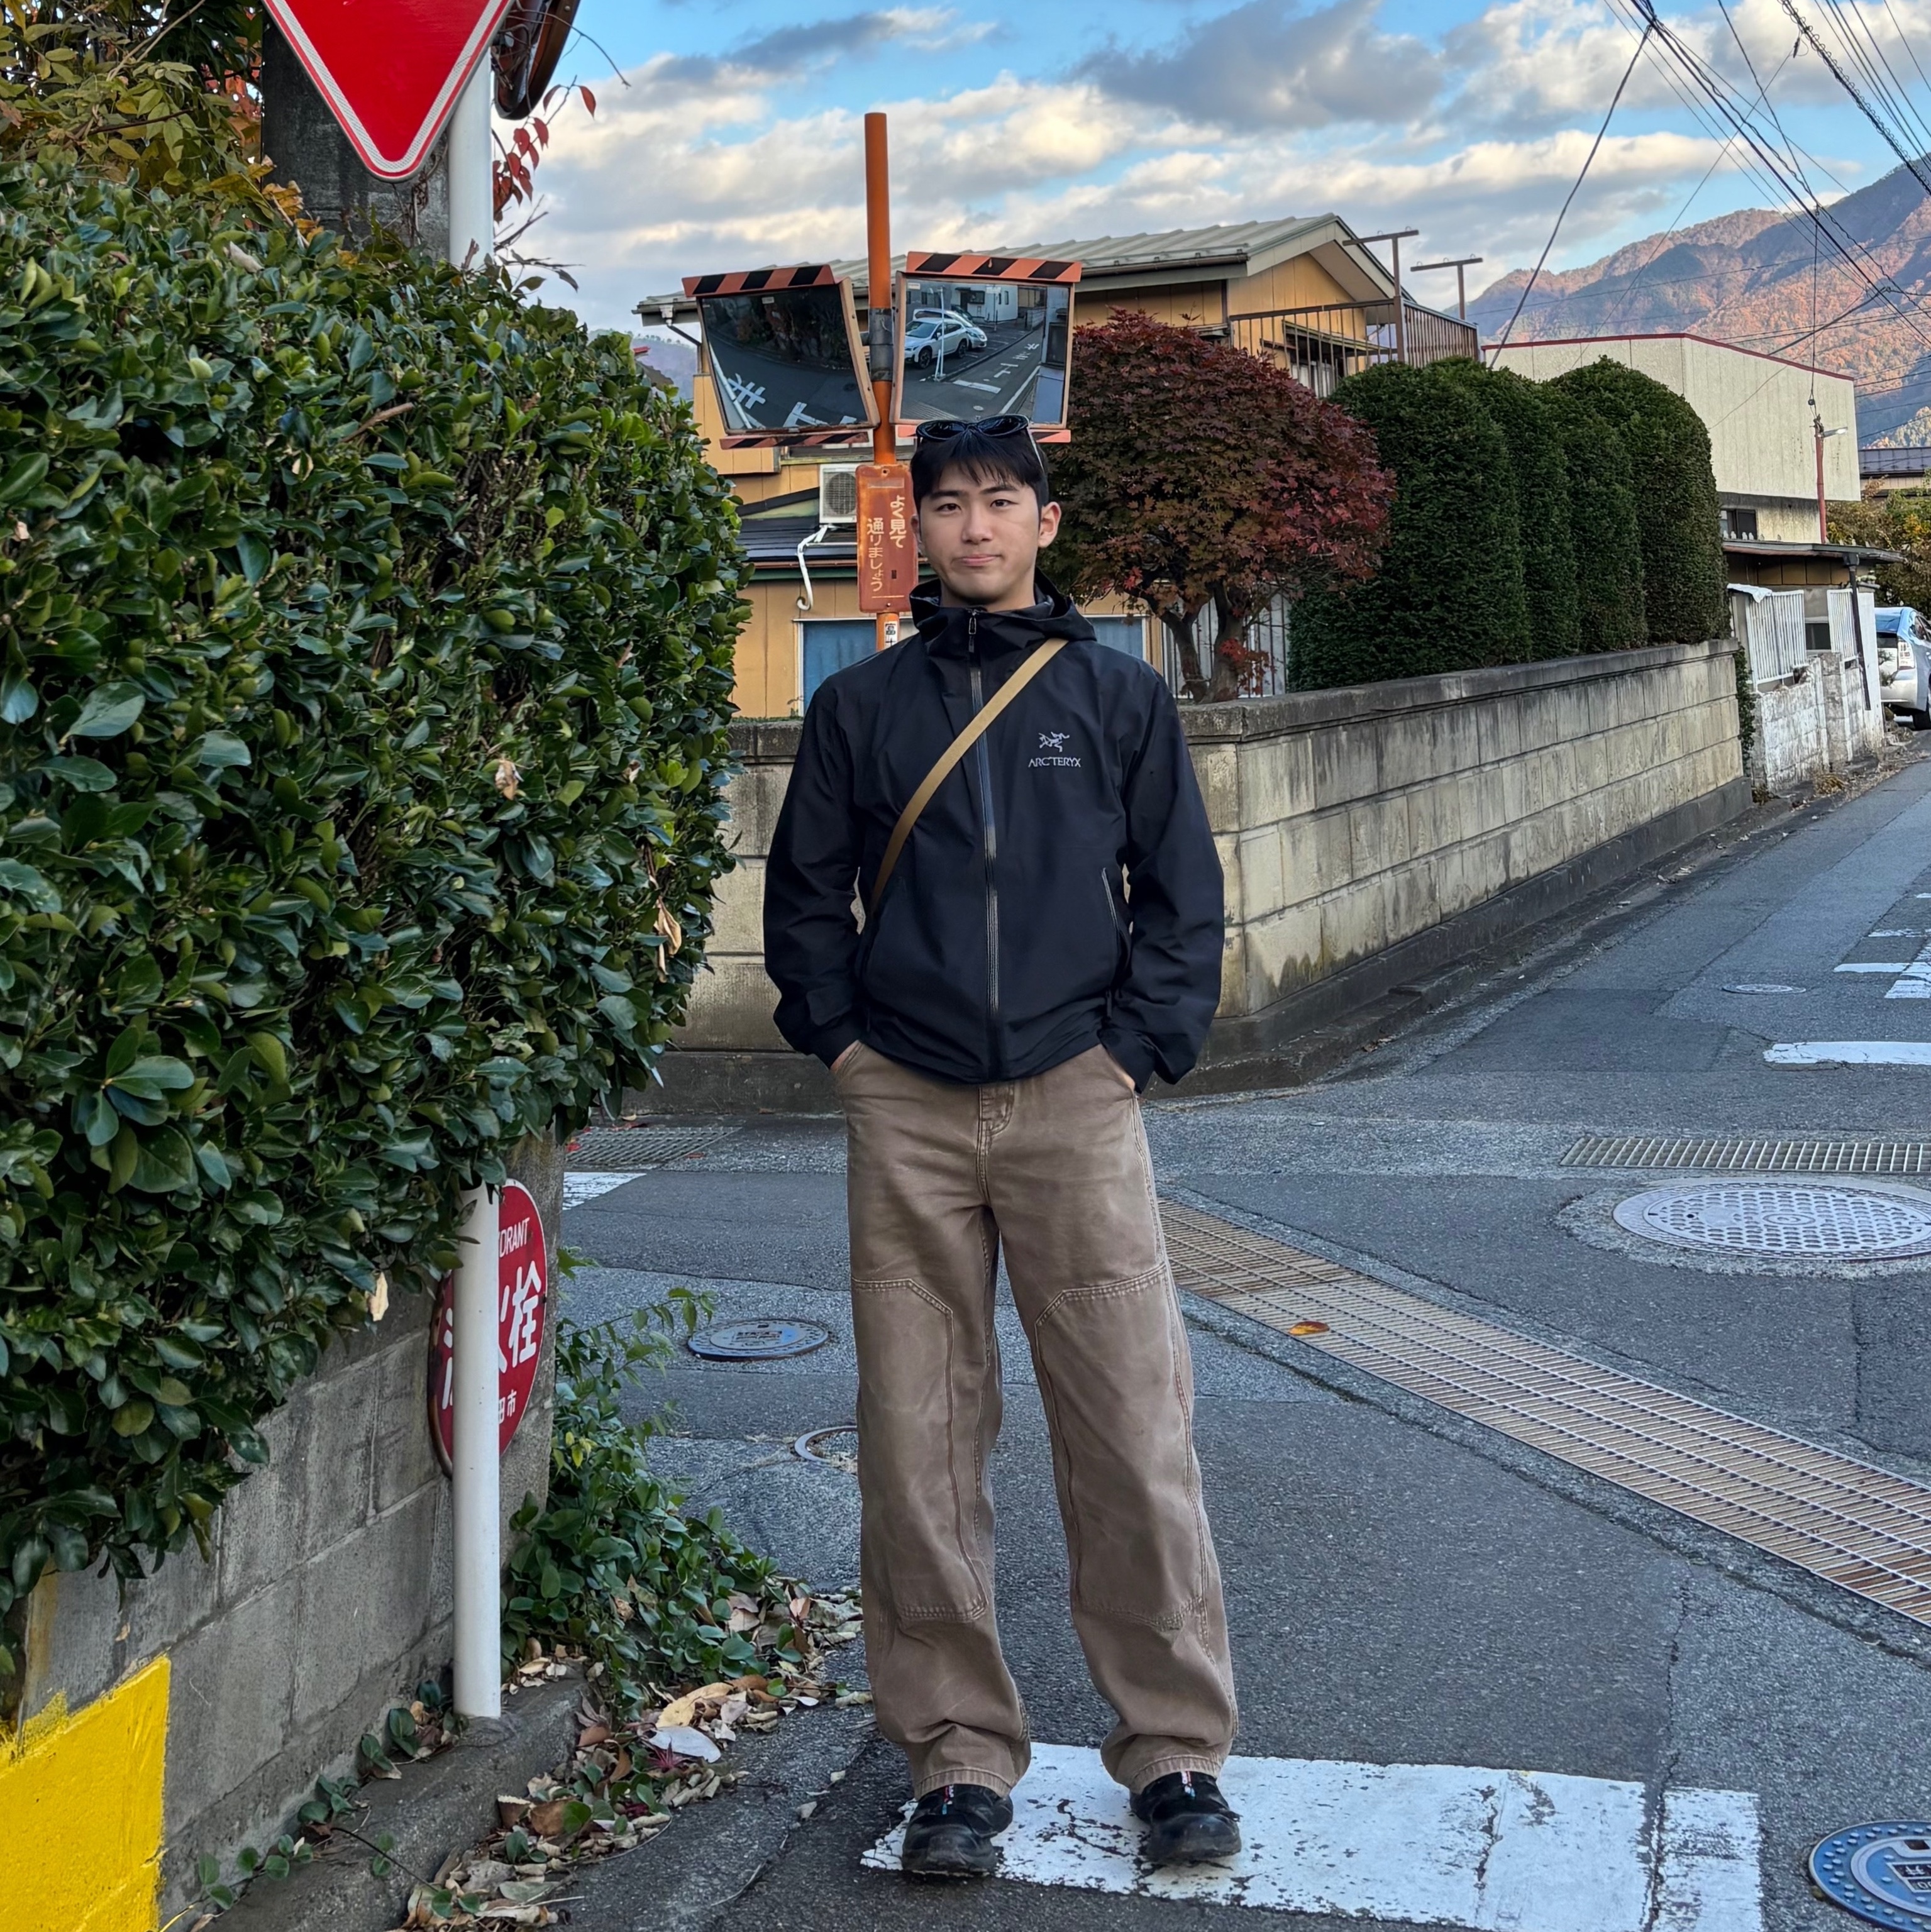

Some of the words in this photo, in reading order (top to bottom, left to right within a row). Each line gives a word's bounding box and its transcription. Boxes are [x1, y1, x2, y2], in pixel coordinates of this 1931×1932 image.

[888, 495, 907, 548] よく見て
[866, 517, 885, 592] 通りましょう
[499, 1217, 530, 1258] DRANT
